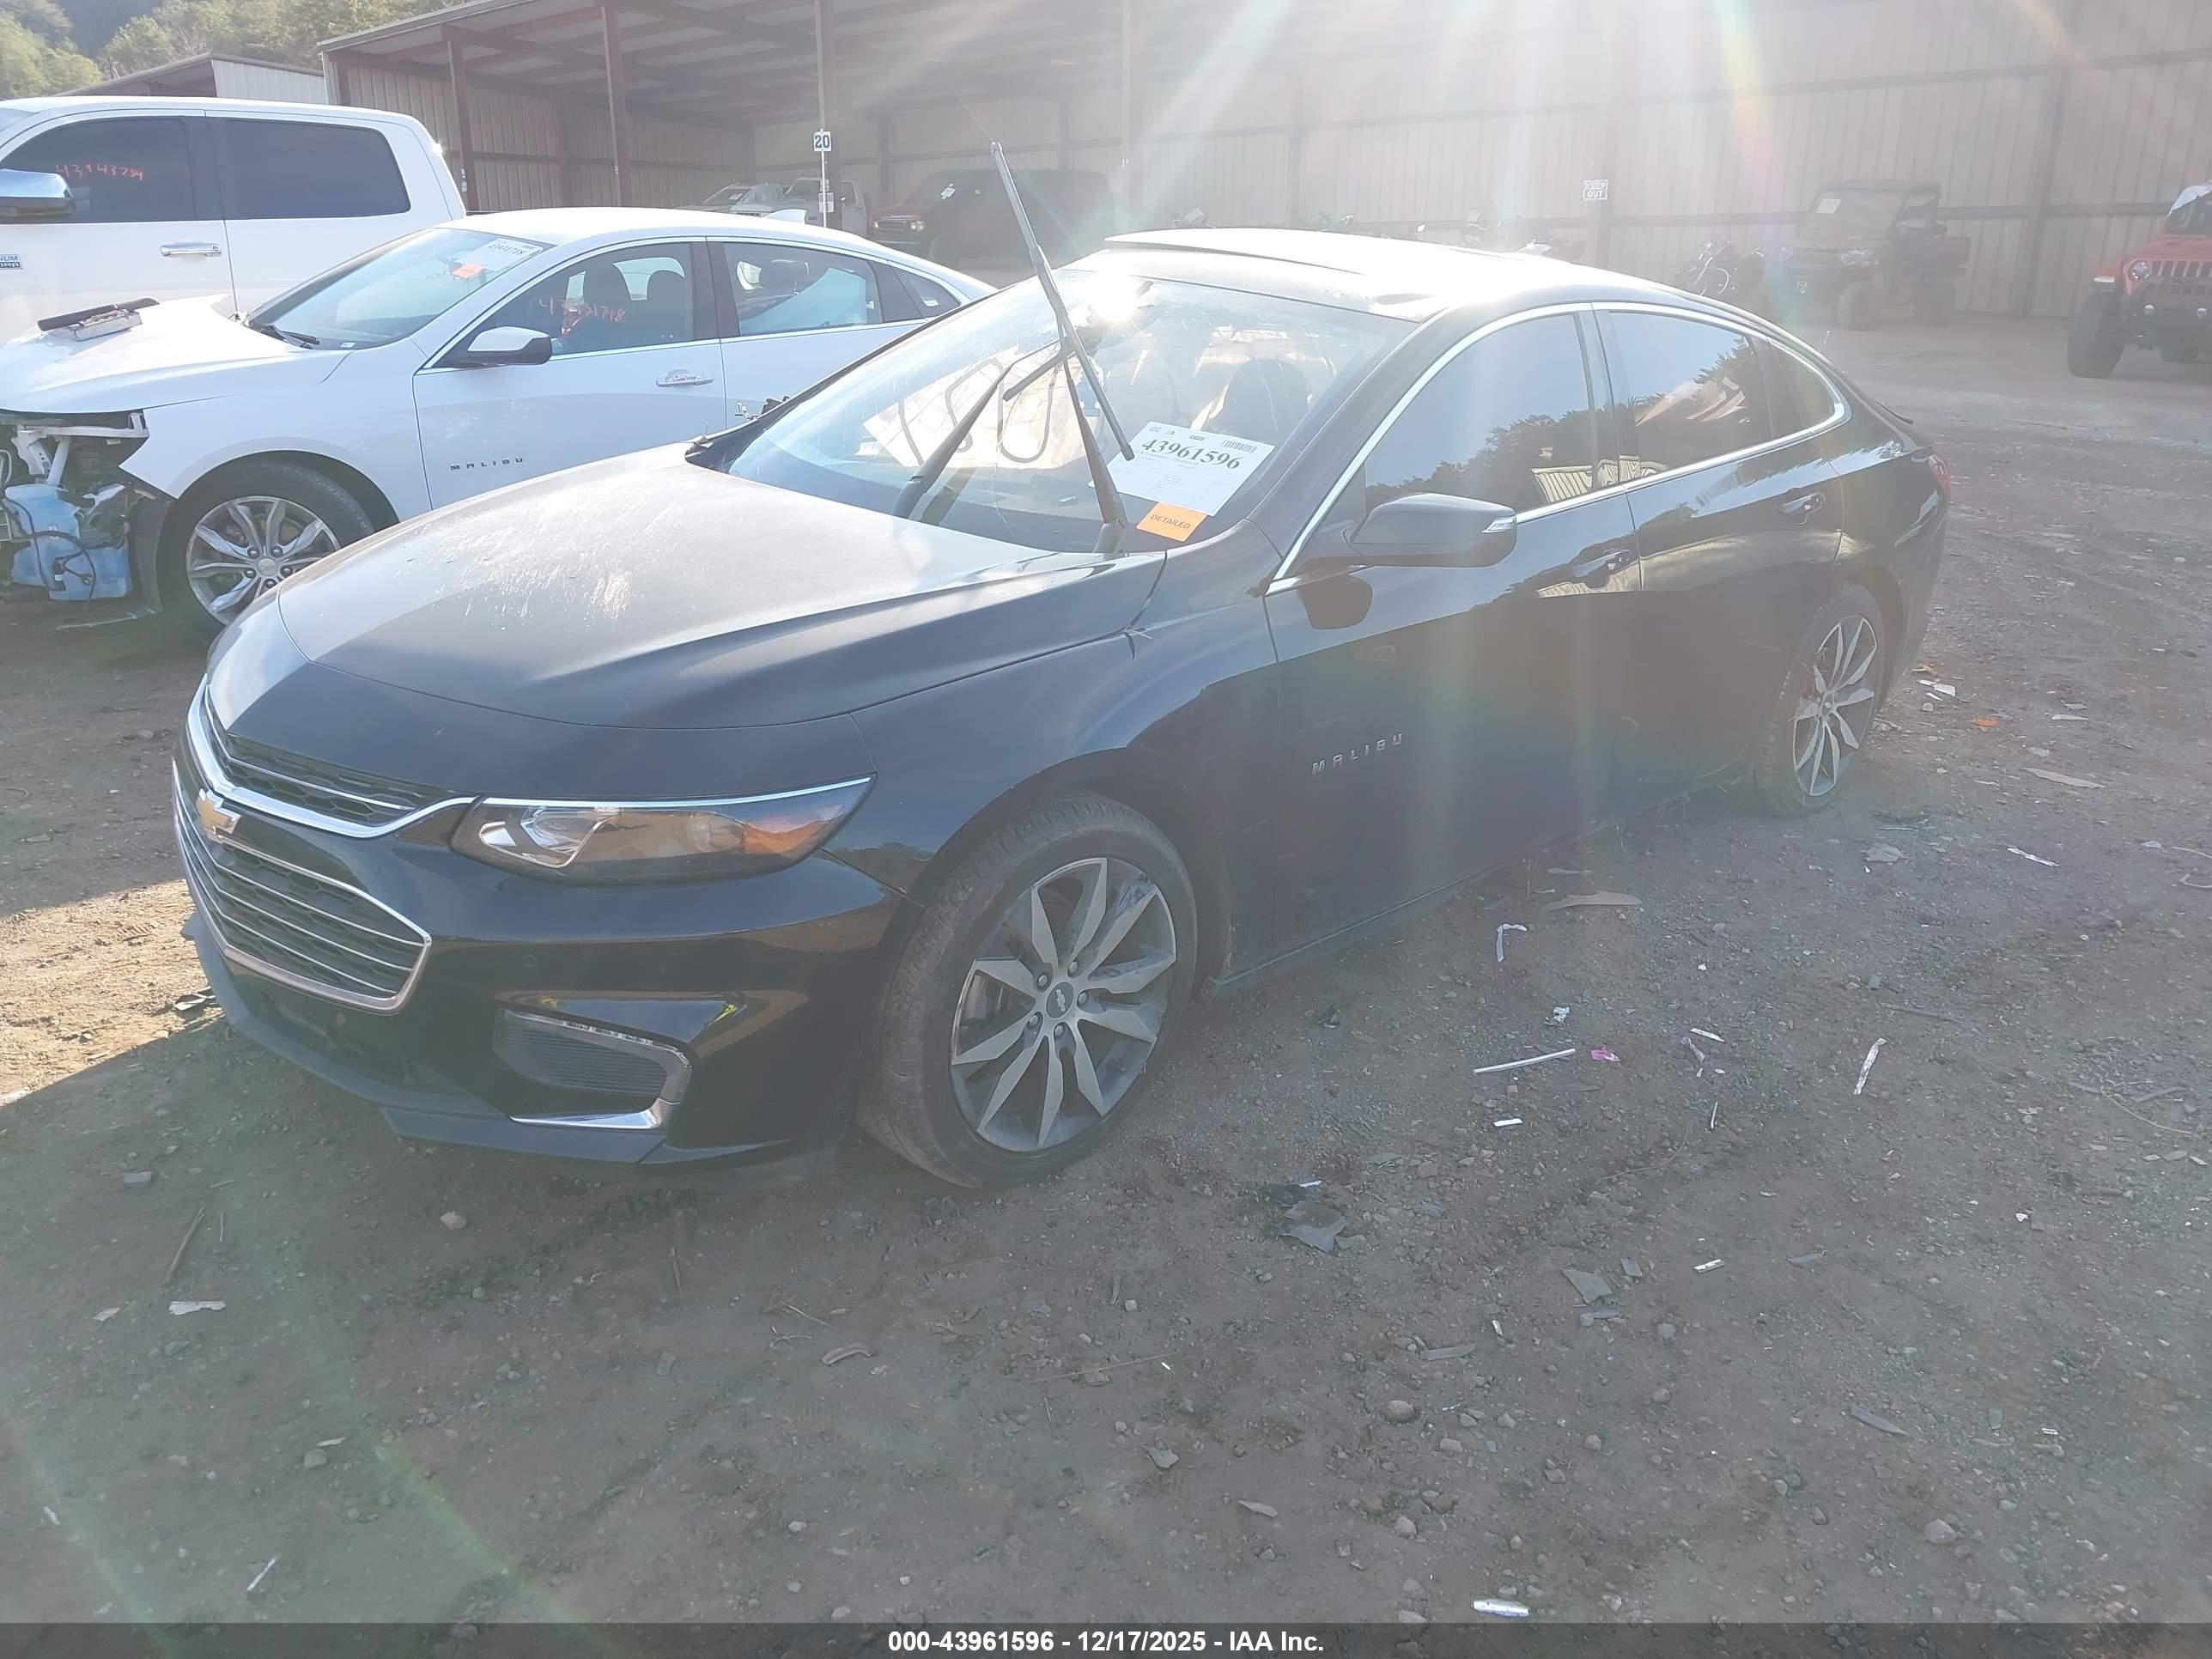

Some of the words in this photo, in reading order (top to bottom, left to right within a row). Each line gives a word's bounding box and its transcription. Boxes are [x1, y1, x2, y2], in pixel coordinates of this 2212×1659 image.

[814, 135, 830, 149] 20
[1140, 438, 1245, 470] 43961596
[449, 456, 523, 471] MALIBU
[1150, 514, 1192, 530] DETAILED
[1311, 733, 1402, 774] MALIBU
